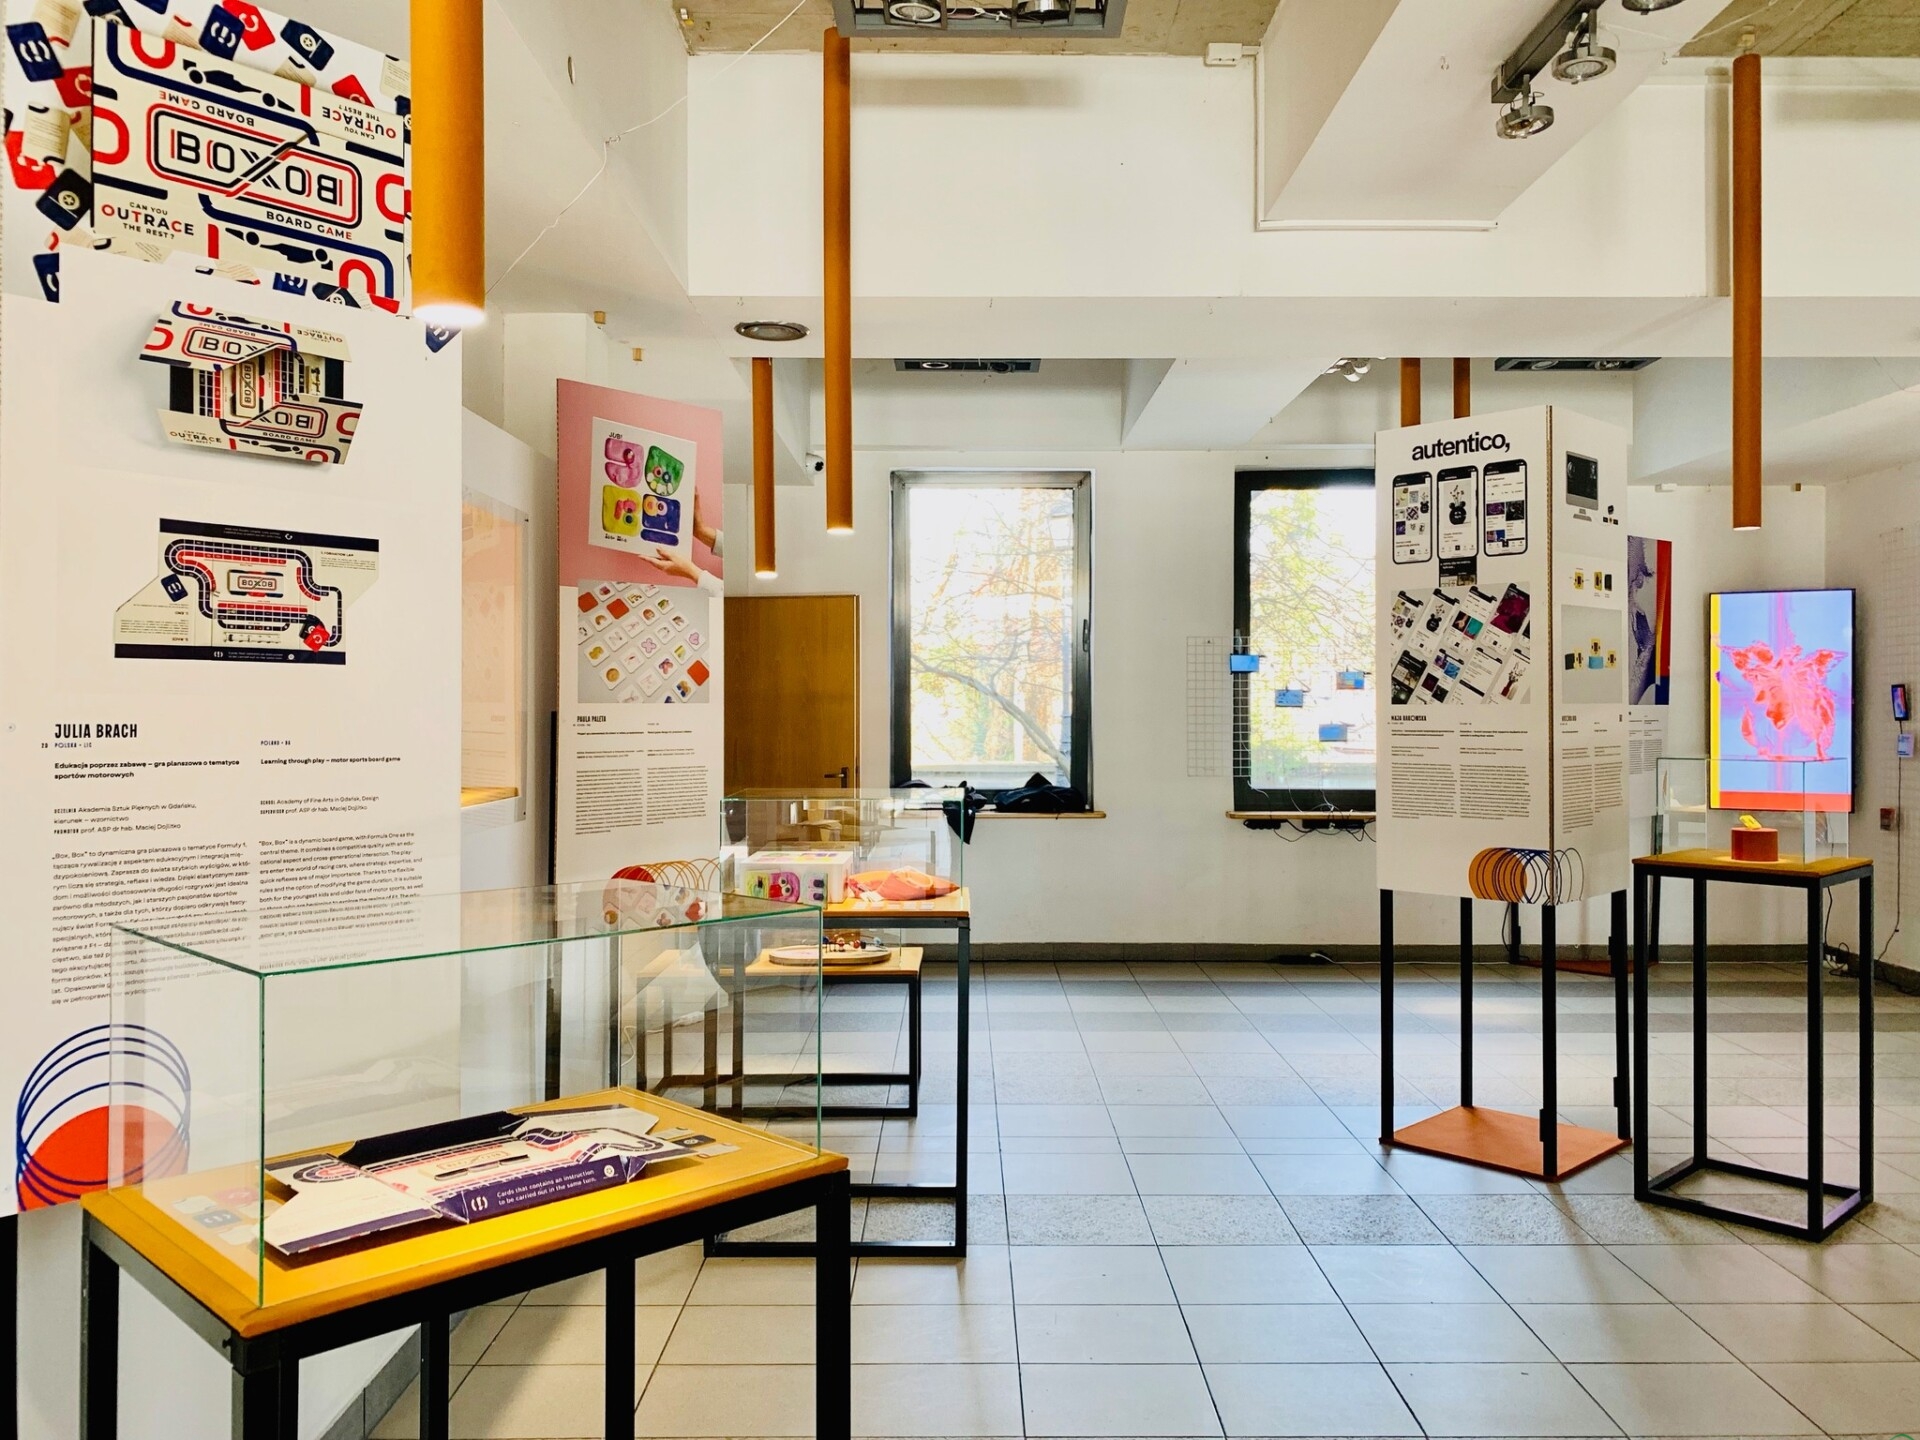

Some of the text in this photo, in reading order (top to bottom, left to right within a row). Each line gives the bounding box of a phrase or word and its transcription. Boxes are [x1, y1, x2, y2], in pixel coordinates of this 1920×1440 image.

[160, 90, 254, 126] BOARD GAME
[322, 106, 396, 138] OUTRACE
[366, 114, 380, 122] THE
[345, 127, 375, 140] CAN YOU
[130, 202, 168, 216] CAN YOU
[102, 204, 194, 235] OUTRACE
[267, 211, 352, 240] BOARD GAME
[123, 223, 141, 232] THE
[1412, 431, 1510, 461] autentico,
[55, 724, 138, 738] JULIA BRACH
[55, 762, 88, 770] Edukacja
[120, 761, 146, 769] zabawę
[167, 760, 202, 768] planszowa
[209, 759, 240, 767] tematyce
[260, 758, 287, 766] Learning
[288, 757, 311, 765] through
[313, 757, 325, 765] play
[350, 756, 368, 764] sports
[54, 771, 134, 780] sportów motorowych
[497, 1189, 514, 1198] Cards
[515, 1185, 528, 1193] that
[529, 1179, 554, 1190] contains
[564, 1170, 594, 1181] instruction
[516, 1192, 536, 1201] carried
